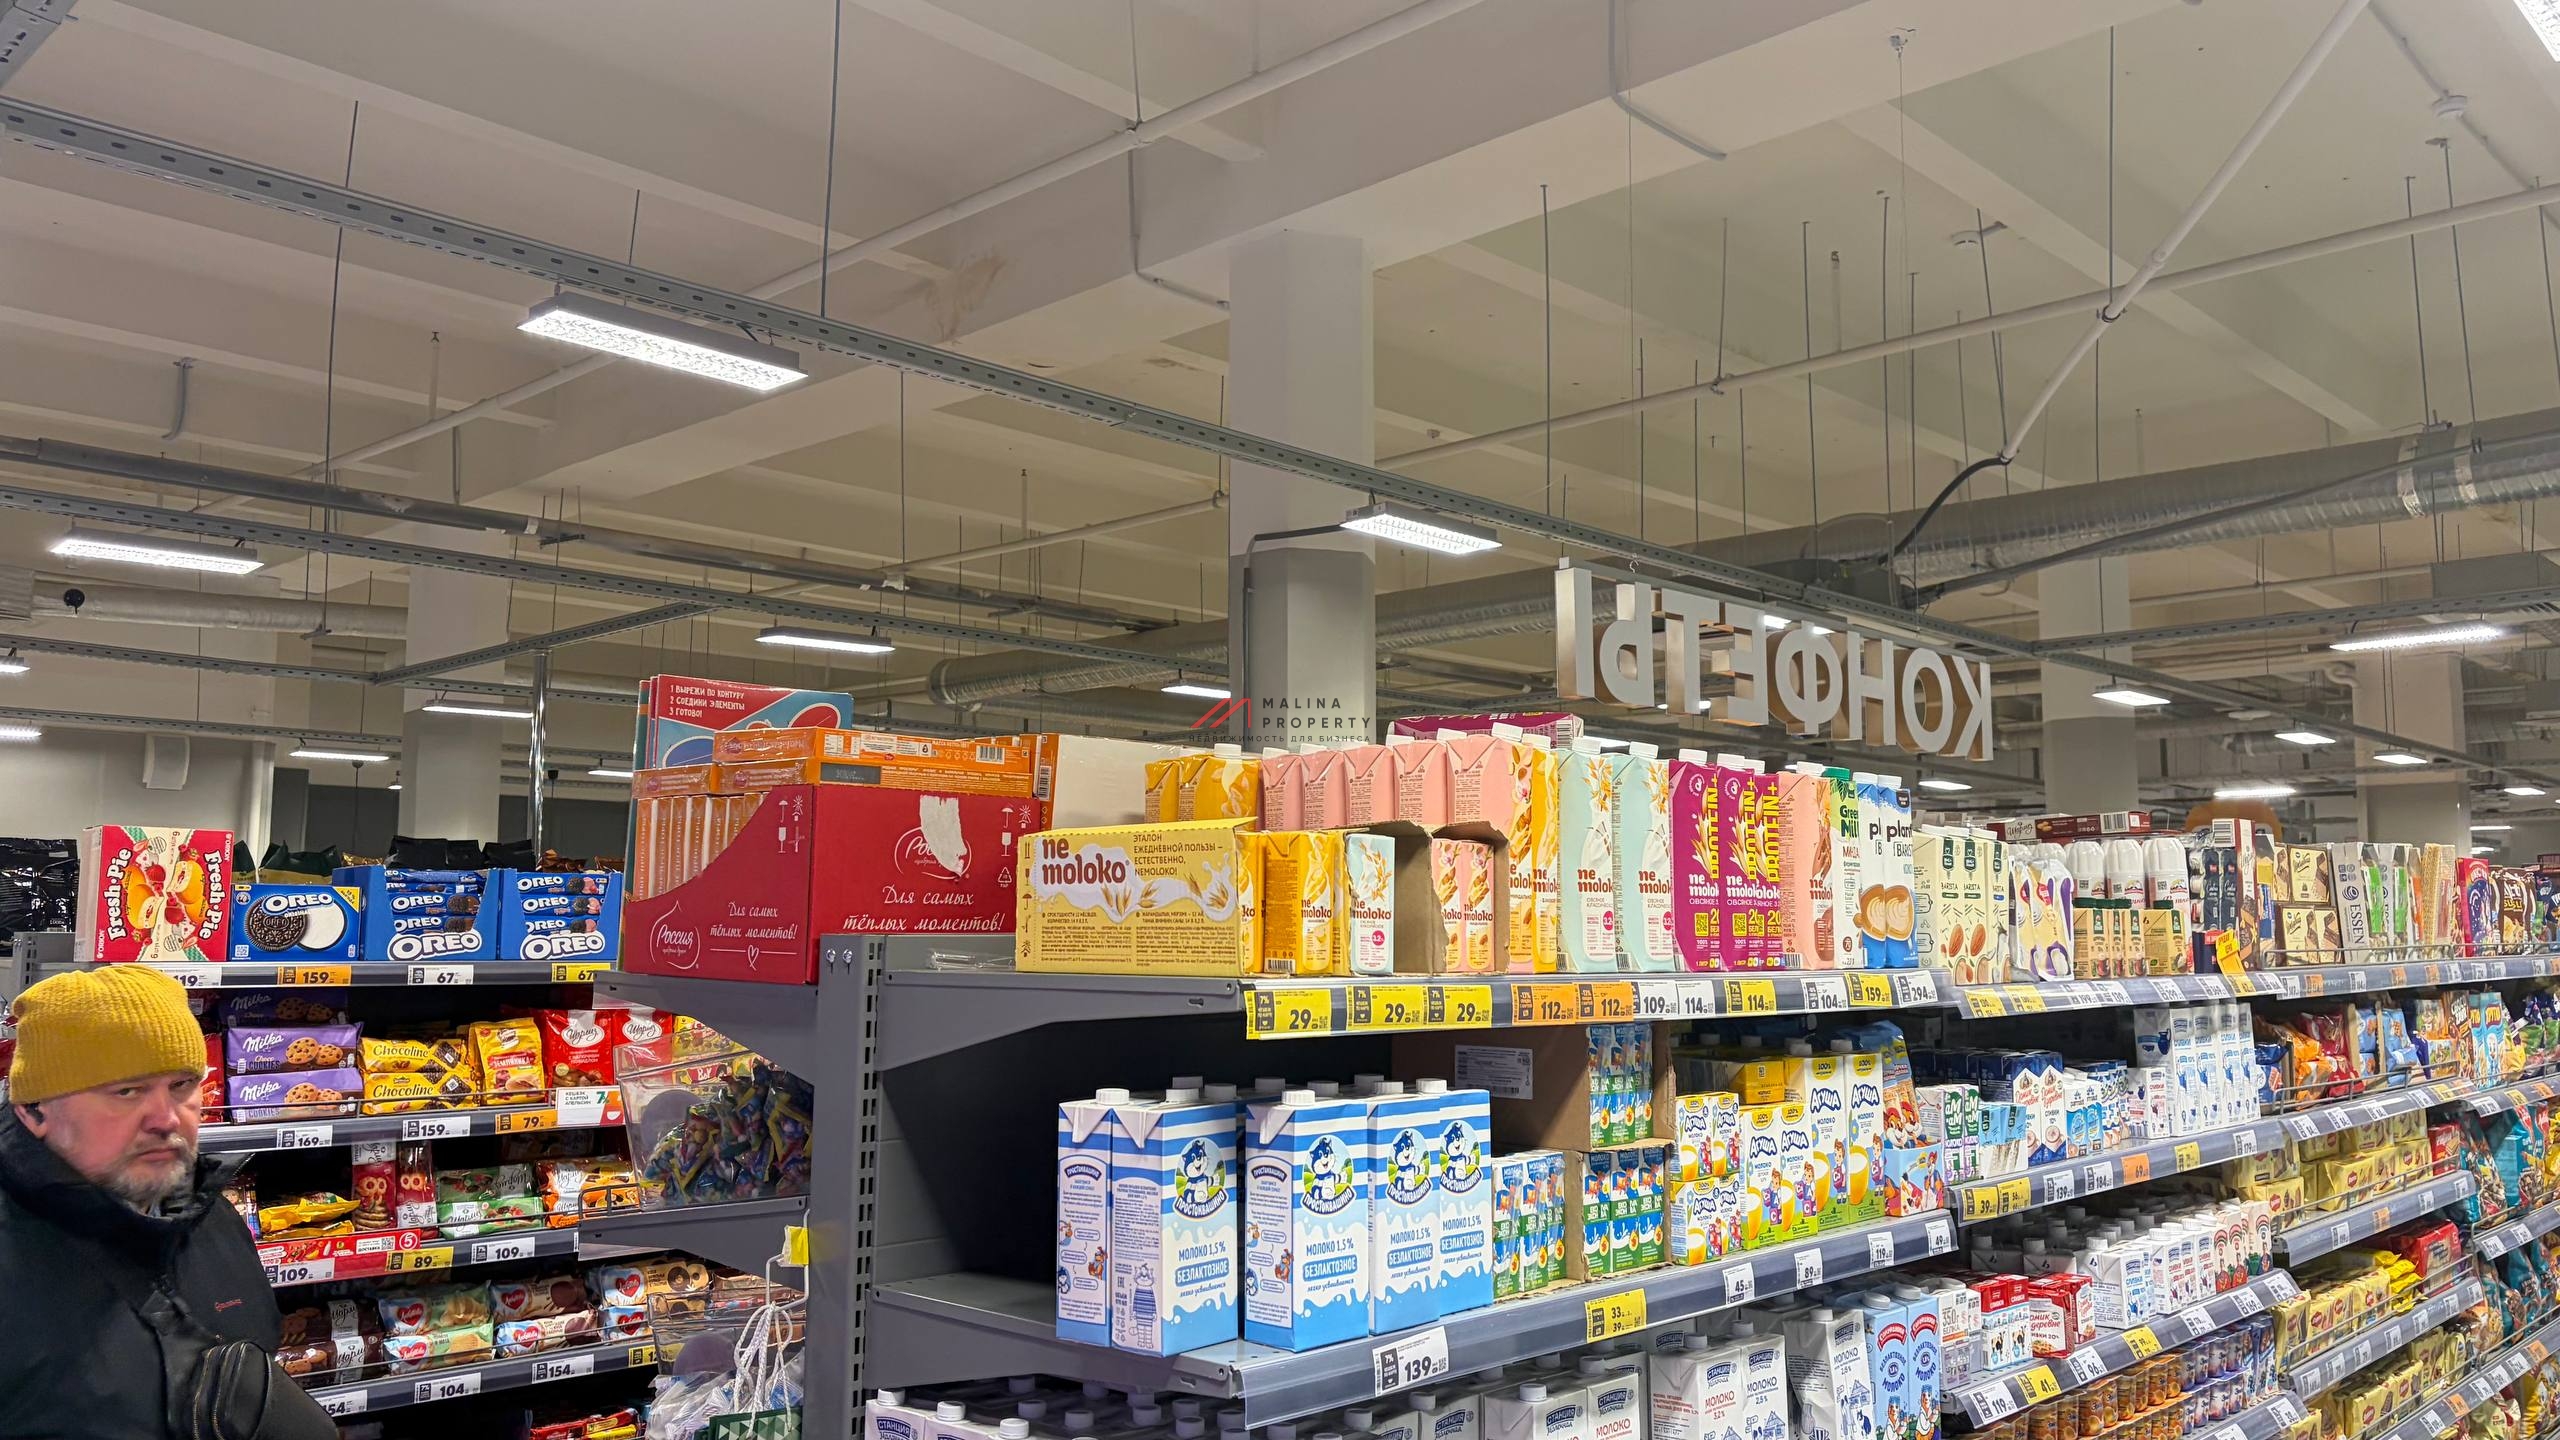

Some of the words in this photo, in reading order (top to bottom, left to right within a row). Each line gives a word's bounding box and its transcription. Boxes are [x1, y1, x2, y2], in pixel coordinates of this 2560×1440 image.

[675, 686, 705, 696] ВЫРЕЖИ
[706, 688, 716, 696] ПО
[718, 690, 744, 699] КОНТУРУ
[676, 697, 707, 707] СОЕДИНИ
[709, 700, 745, 710] ЭЛЕМЕНТЫ
[675, 708, 703, 718] ГОТОВО!
[1133, 834, 1163, 843] ЭТАЛОН
[1042, 837, 1070, 859] ne
[1133, 843, 1184, 853] ЕЖЕДНЕВНОЙ
[1184, 842, 1216, 852] ПОЛЬЗЫ
[1134, 855, 1186, 865] ЕСТЕСТВЕННО,
[1042, 853, 1126, 885] moloko
[1134, 866, 1178, 876] NEMOLOKO!
[1577, 868, 1596, 880] ne
[1638, 870, 1656, 881] ne
[517, 876, 564, 890] OREO
[1578, 877, 1613, 893] molok
[1689, 873, 1706, 885] ne
[1726, 875, 1743, 886] ne
[1809, 878, 1824, 889] ne
[882, 884, 916, 904] Для
[922, 891, 975, 905] самых
[265, 893, 333, 913] OREO
[392, 895, 444, 911] OREO
[522, 896, 569, 911] OREO
[728, 901, 746, 917] Для
[749, 906, 778, 917] самых
[1301, 906, 1333, 919] moloko
[1352, 907, 1392, 920] moloko
[1464, 910, 1494, 921] moloko
[394, 916, 441, 932] OREO
[843, 912, 907, 931] тёплых
[914, 913, 1006, 931] моментов!
[2350, 903, 2365, 944] ESSEN
[657, 924, 693, 949] Россия
[710, 923, 742, 937] тёплых
[745, 923, 798, 940] моментов!
[391, 933, 481, 959] OREO
[524, 934, 604, 960] OREO
[302, 972, 328, 984] 159
[436, 973, 454, 984] 67
[577, 970, 593, 981] 67
[1821, 995, 1838, 1009] 104
[1865, 987, 1881, 1001] 159
[1911, 987, 1928, 1001] 294
[230, 995, 271, 1010] Milka
[1541, 1001, 1561, 1019] 112
[1601, 998, 1620, 1016] 112
[1643, 996, 1665, 1013] 109
[1685, 997, 1703, 1013] 114
[1748, 994, 1764, 1011] 114
[1288, 1008, 1312, 1030] 29
[1384, 1003, 1405, 1023] 29
[1456, 1003, 1476, 1021] 29
[242, 1032, 284, 1053] Milka
[254, 1055, 274, 1063] Choco
[372, 1044, 430, 1058] Chocoline
[248, 1060, 280, 1070] COOKIES
[240, 1080, 281, 1102] Milka
[373, 1084, 433, 1098] Chocoline
[1851, 1083, 1880, 1109] АГУША
[1810, 1088, 1842, 1114] АГУША
[523, 1116, 540, 1128] 79
[1684, 1115, 1706, 1132] АГУША
[1816, 1117, 1836, 1125] МОЛОКО
[1857, 1111, 1875, 1120] МОЛОКО
[420, 1124, 445, 1136] 159
[297, 1136, 319, 1147] 169
[1749, 1136, 1778, 1159] АГУША
[1780, 1130, 1810, 1152] АГУША
[1786, 1155, 1804, 1163] МОЛОКО
[2135, 1166, 2143, 1177] 69
[1440, 1168, 1482, 1193] ПРОСТОКВАШИНО
[1387, 1176, 1431, 1204] ПРОСТОКВАШИНО
[2056, 1187, 2068, 1200] 139
[1175, 1190, 1227, 1218] ПРОСТОКВАШИНО
[1303, 1189, 1355, 1214] ПРОСТОКВАШИНО
[1693, 1197, 1717, 1215] АГУША
[1980, 1200, 1991, 1214] 39
[1442, 1217, 1467, 1232] МОЛОКО
[1390, 1229, 1415, 1245] МОЛОКО
[1440, 1230, 1484, 1253] БЕЗЛАКТОЗНОЕ
[1935, 1235, 1944, 1246] 49
[494, 1246, 520, 1259] 109
[1178, 1243, 1208, 1262] МОЛОКО
[1306, 1240, 1336, 1257] МОЛОКО
[1388, 1243, 1434, 1268] БЕЗЛАКТОЗНОЕ
[1875, 1248, 1887, 1260] 119
[414, 1257, 432, 1268] 89
[1303, 1255, 1358, 1279] БЕЗЛАКТОЗНОЕ
[279, 1268, 308, 1281] 109
[1177, 1259, 1229, 1283] БЕЗЛАКТОЗНОЕ
[1804, 1266, 1814, 1279] 89
[1734, 1279, 1745, 1293] 45
[1611, 1307, 1622, 1319] 33
[1612, 1323, 1622, 1333] 39
[1748, 1350, 1774, 1367] СТАНЦИЯ
[1833, 1347, 1859, 1364] МОЛОКО
[548, 1365, 570, 1377] 154
[1404, 1356, 1432, 1382] 139
[1706, 1363, 1731, 1381] СТАНЦИЯ
[1915, 1362, 1937, 1382] МОЛОКО
[2088, 1363, 2099, 1375] 96
[1746, 1376, 1778, 1394] МОЛОКО
[1882, 1372, 1906, 1393] МОЛОКО
[2040, 1380, 2050, 1393] 41
[440, 1385, 465, 1397] 104
[1598, 1389, 1627, 1408] СТАНЦИЯ
[1705, 1390, 1735, 1408] МОЛОКО
[1991, 1395, 2006, 1409] 119
[1435, 1411, 1465, 1432] СТАНЦИЯ
[1547, 1406, 1576, 1426] СТАНЦИЯ
[878, 1418, 911, 1437] СТАНЦИЯ
[1596, 1418, 1631, 1437] МОЛОКО
